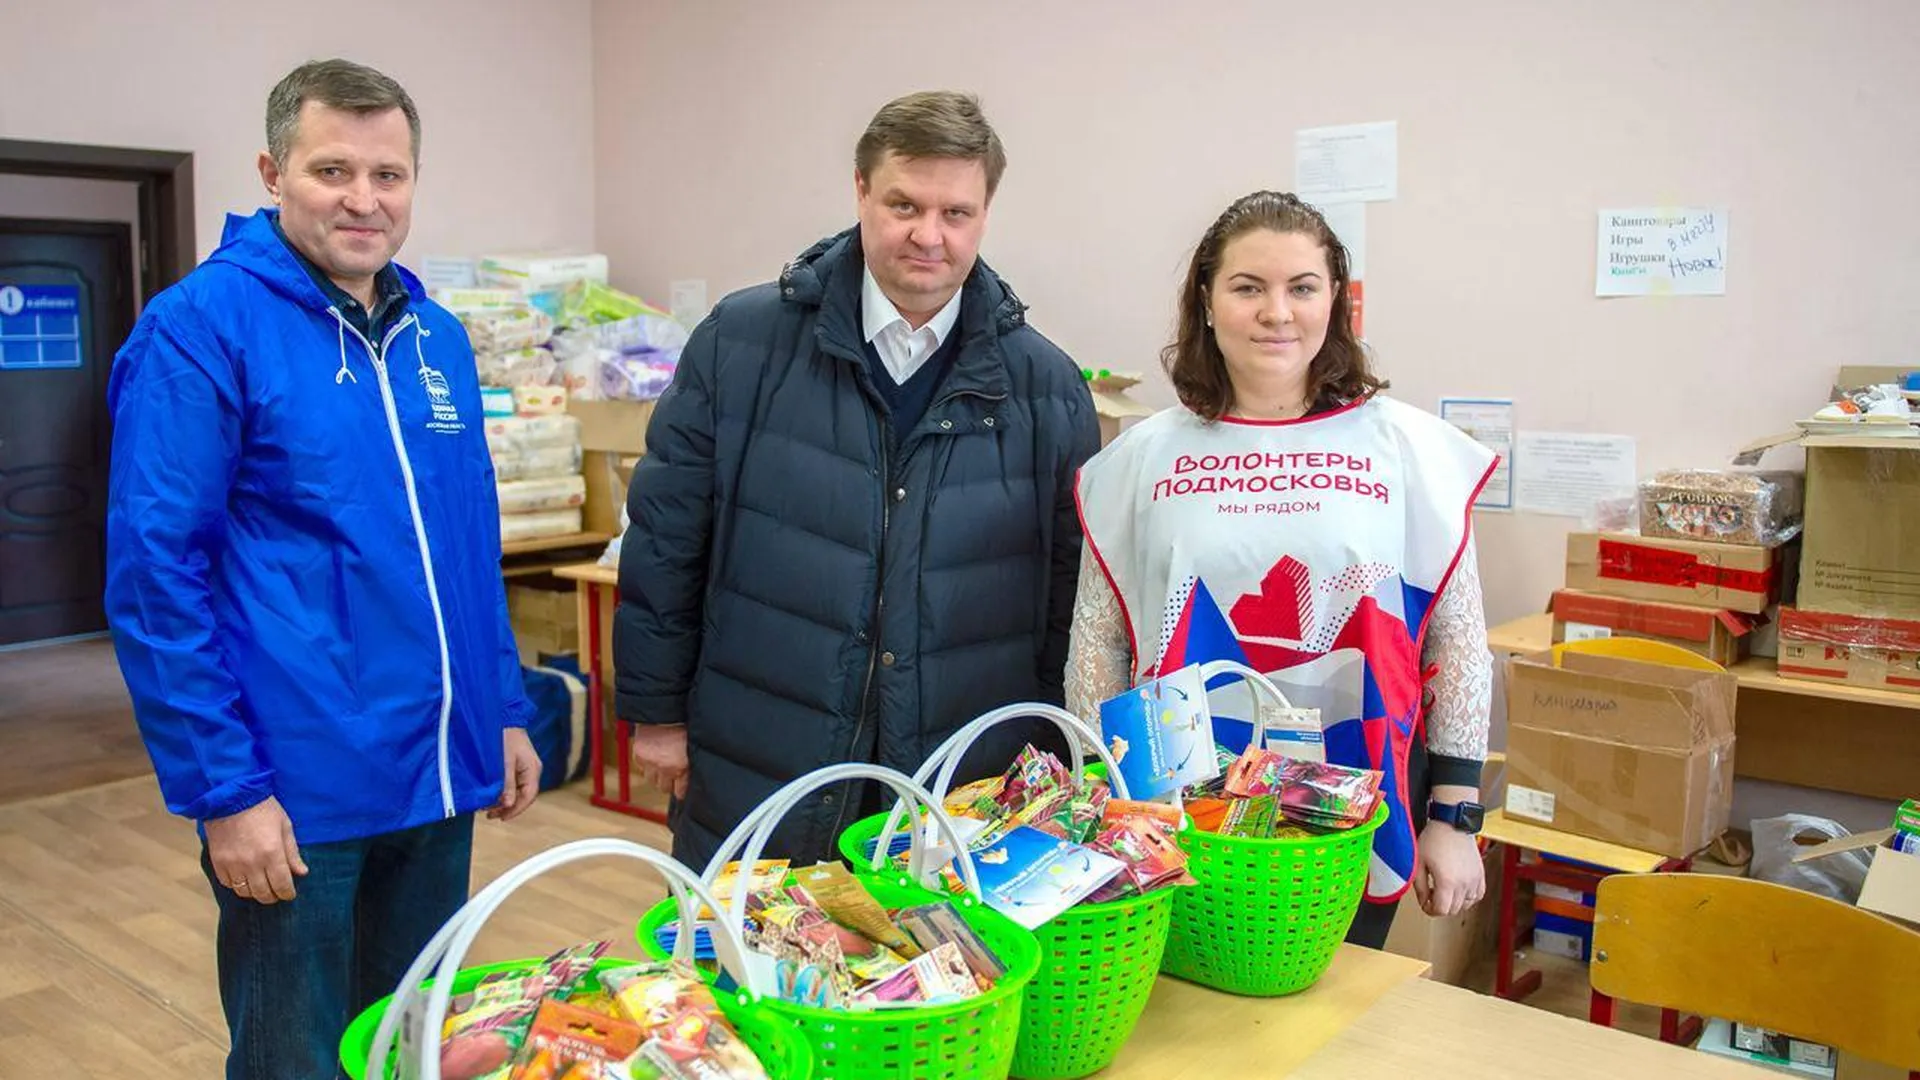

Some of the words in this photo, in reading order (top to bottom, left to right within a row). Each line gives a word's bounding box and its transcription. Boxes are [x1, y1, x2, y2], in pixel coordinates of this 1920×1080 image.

[1611, 234, 1644, 246] Игры
[1609, 252, 1666, 265] Игрушки
[1174, 453, 1371, 474] ВОЛОНТЕРЫ
[1153, 473, 1389, 504] ПОДМОСКОВЬЯ
[1217, 503, 1248, 514] МЫ
[1254, 501, 1321, 514] РЯДОМ
